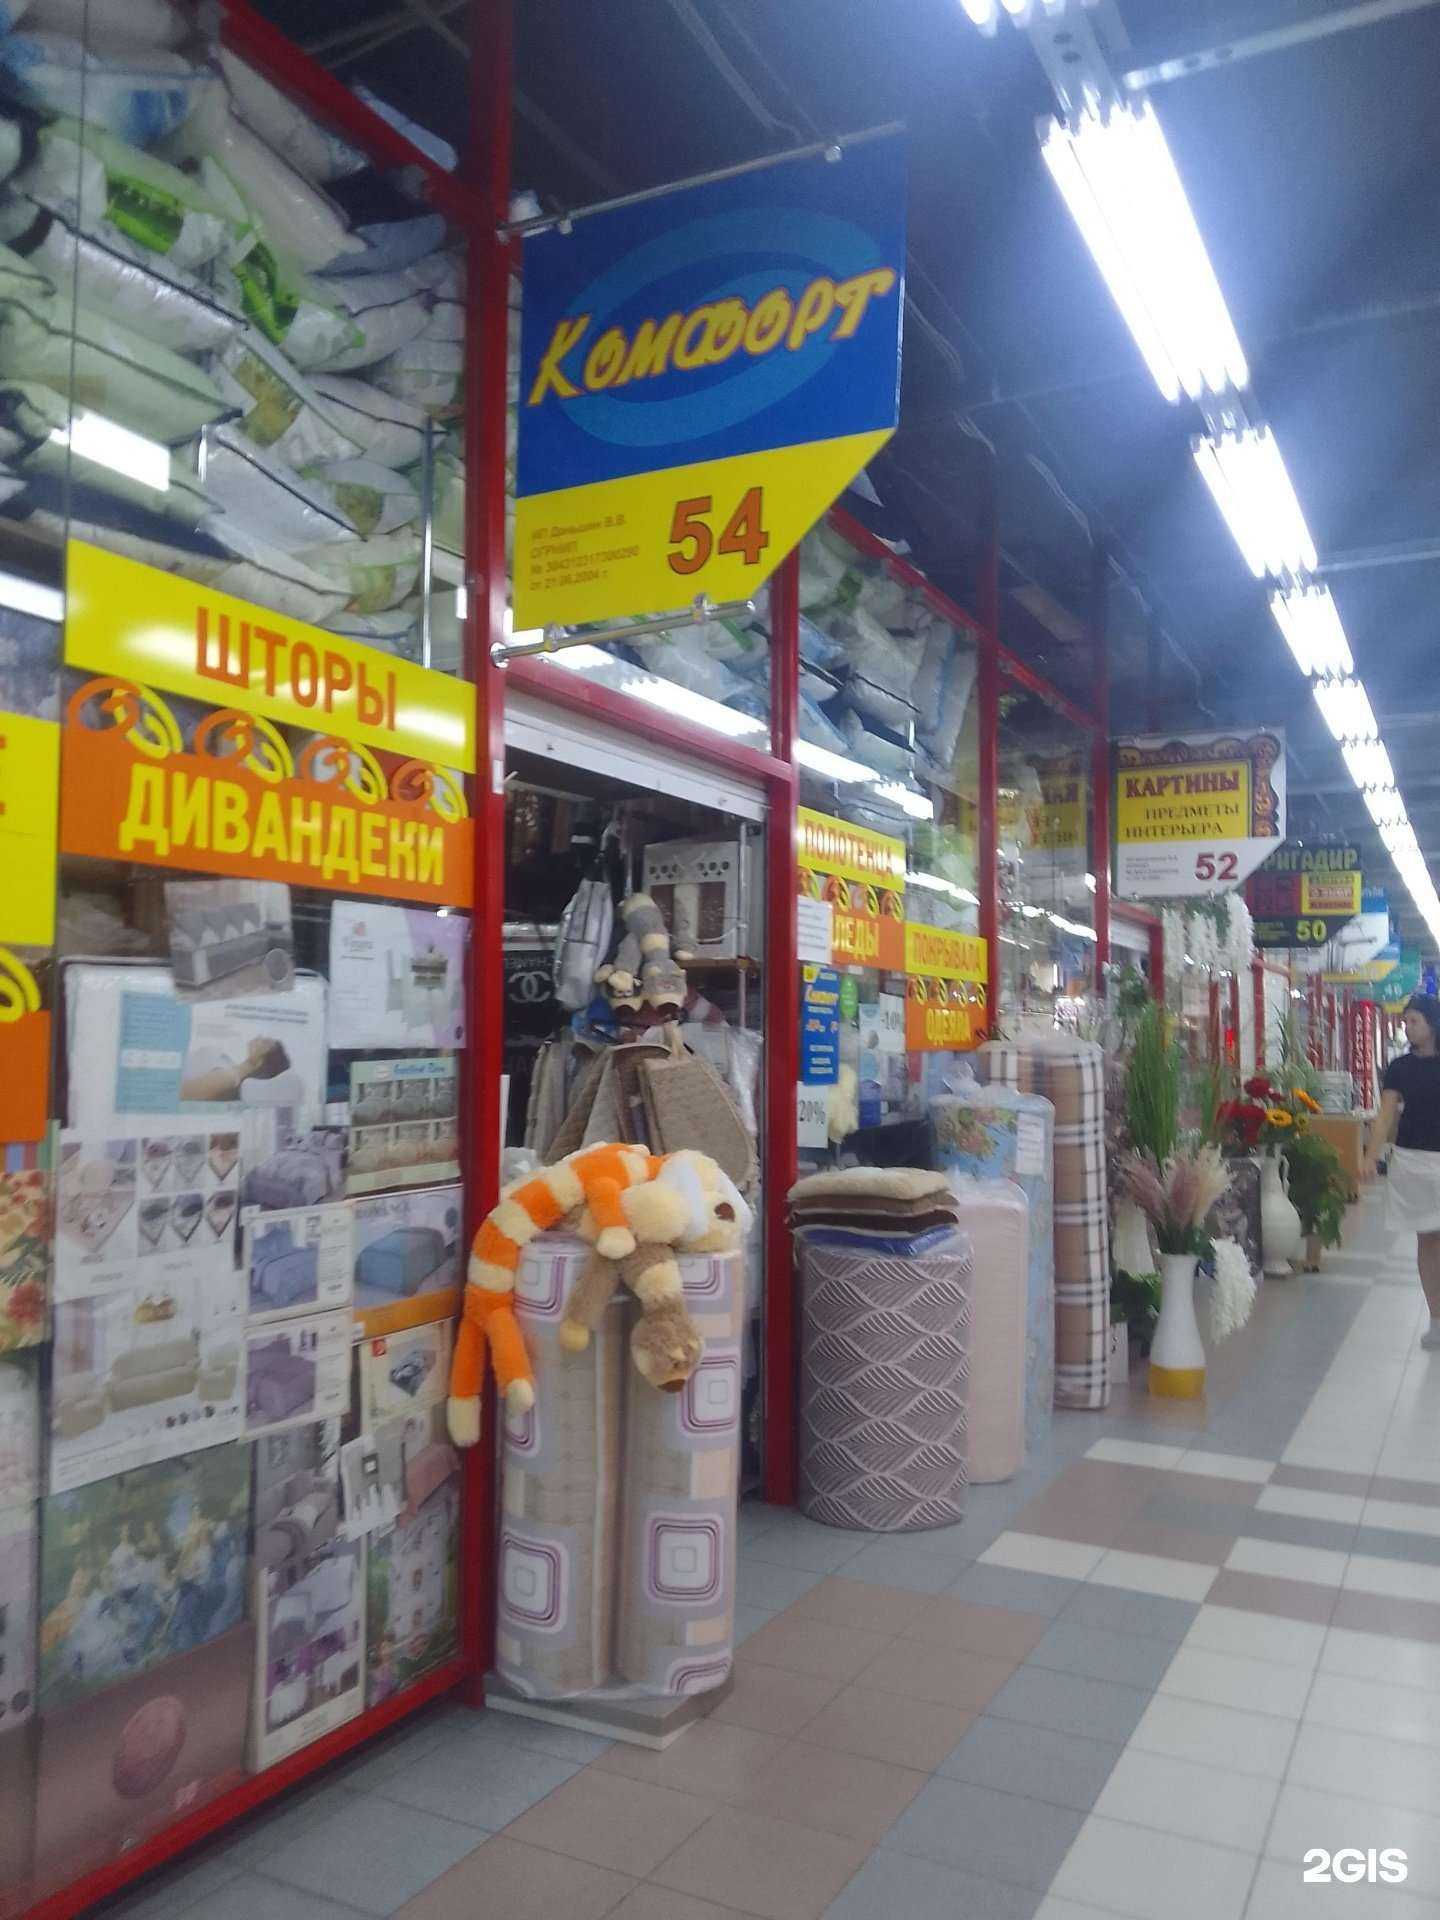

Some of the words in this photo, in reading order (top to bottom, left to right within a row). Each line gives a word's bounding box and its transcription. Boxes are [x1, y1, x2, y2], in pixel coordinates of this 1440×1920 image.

[667, 486, 769, 575] 54
[195, 606, 397, 731] ШТОРЫ
[1126, 769, 1239, 799] КАРТИНЫ
[118, 762, 446, 886] ДИВАНДЕКИ
[1144, 803, 1240, 820] ПРЕДМЕТЫ
[1125, 822, 1224, 839] ИНТЕРЬЕРА
[1195, 851, 1238, 880] 52
[1262, 847, 1358, 872] РИГАДИР
[831, 913, 880, 961] ЛЕДЫ
[1296, 919, 1327, 942] 50
